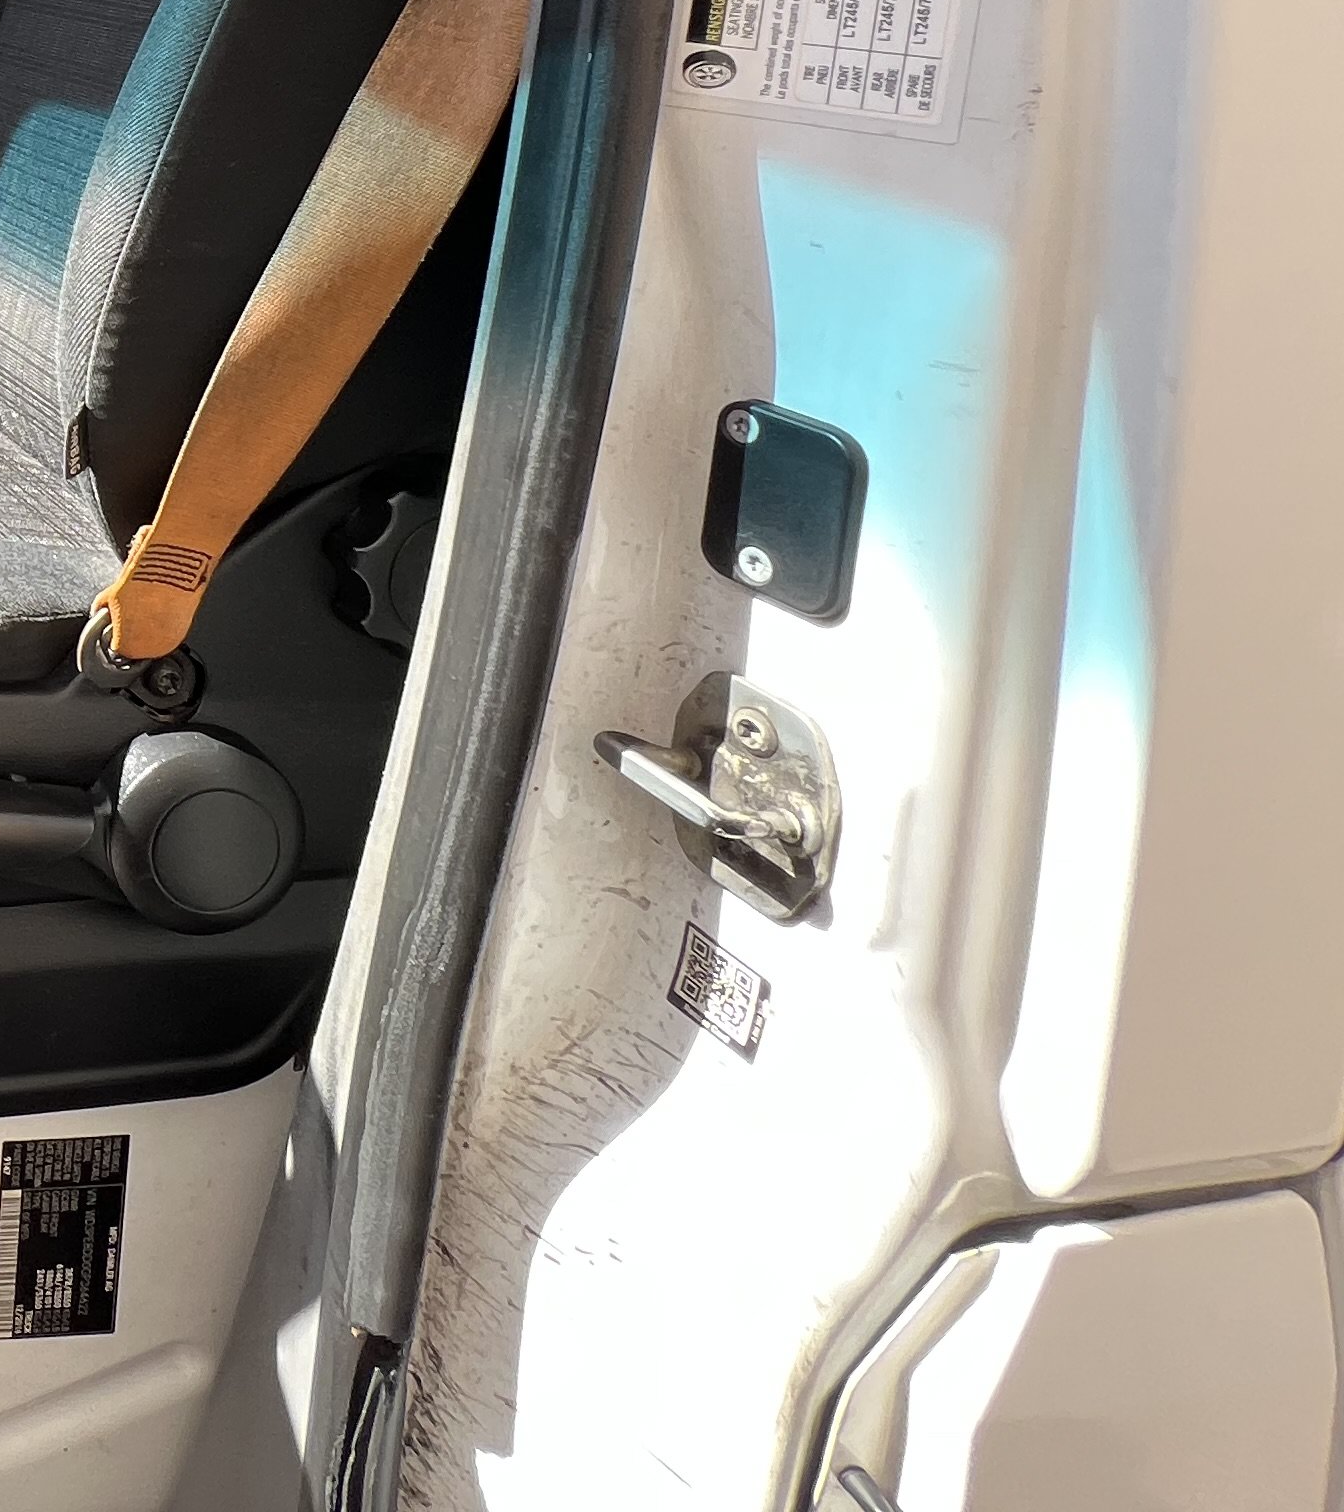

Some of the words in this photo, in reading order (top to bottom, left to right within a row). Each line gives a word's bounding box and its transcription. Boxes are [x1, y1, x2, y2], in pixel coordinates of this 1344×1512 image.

[740, 3, 759, 39] NOMBRE
[836, 65, 850, 90] FRONT
[849, 65, 864, 94] AVANT
[920, 64, 937, 99] SECOURS
[917, 100, 931, 112] DE
[86, 1189, 97, 1206] VIN
